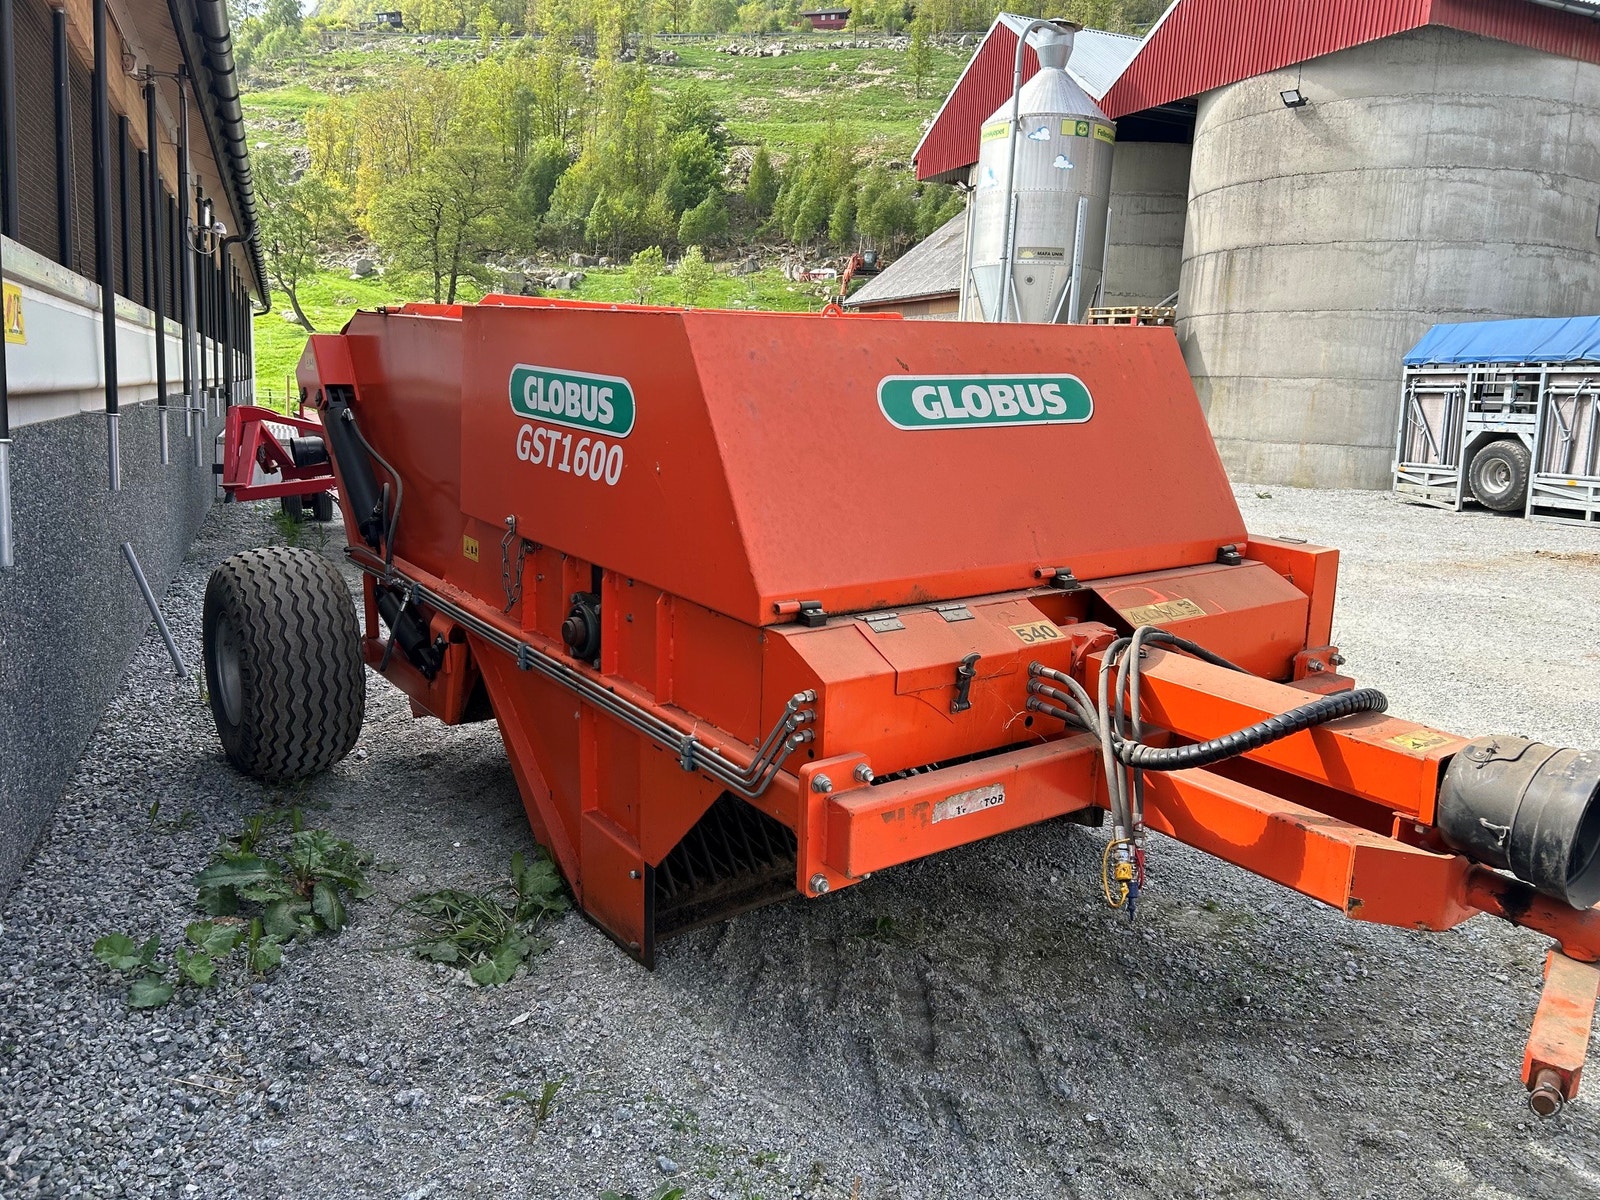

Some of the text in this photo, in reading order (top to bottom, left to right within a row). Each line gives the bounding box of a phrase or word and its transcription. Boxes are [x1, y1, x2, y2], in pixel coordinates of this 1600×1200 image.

[523, 376, 614, 424] GLOBUS
[911, 384, 1067, 419] GLOBUS
[516, 424, 623, 486] GST1600
[1015, 625, 1058, 642] 540
